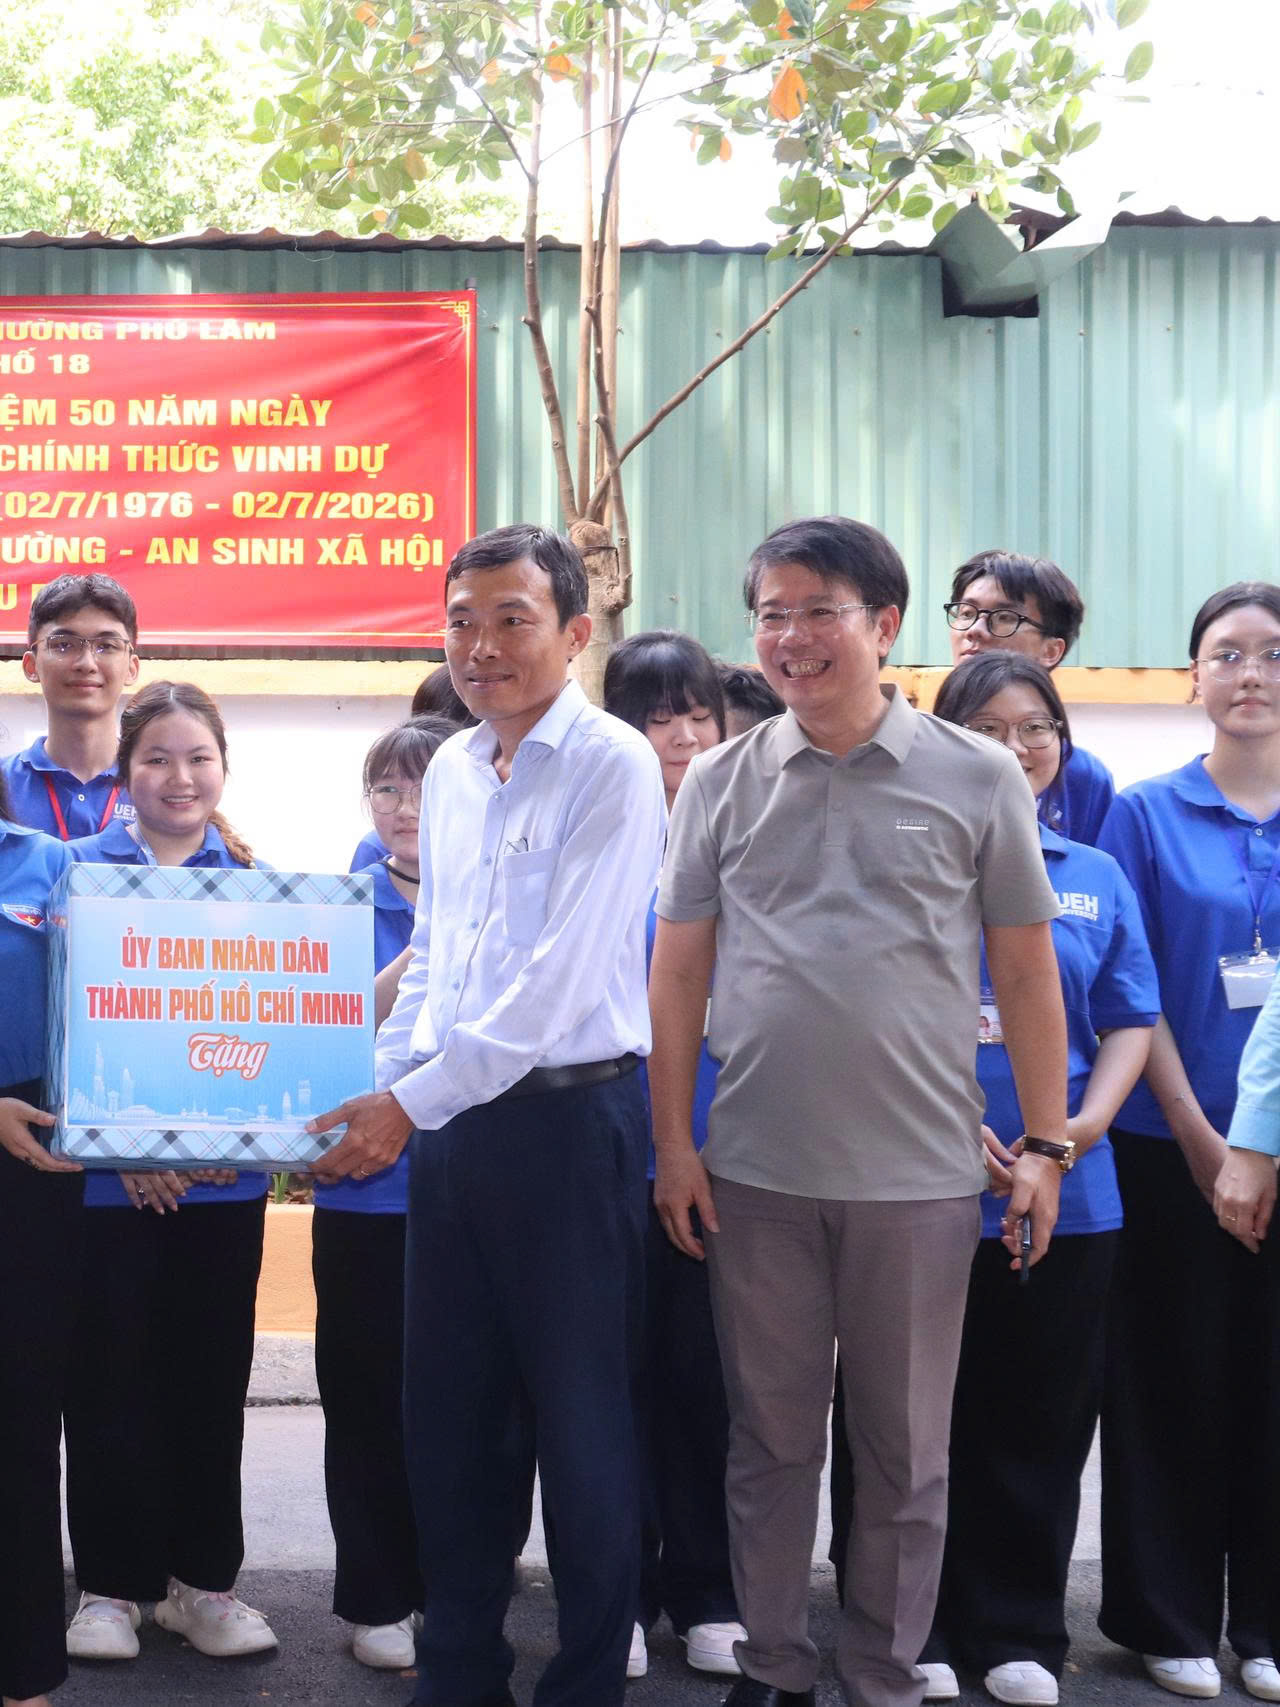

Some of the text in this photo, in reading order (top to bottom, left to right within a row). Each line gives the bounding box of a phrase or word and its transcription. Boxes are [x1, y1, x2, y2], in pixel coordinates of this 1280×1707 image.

[47, 353, 91, 375] 18
[69, 399, 116, 427] 50
[127, 393, 218, 427] NĂM
[229, 393, 332, 427] NGÀY
[121, 439, 219, 473] THỨC
[231, 444, 322, 473] VINH
[334, 442, 390, 479] DỰ
[232, 491, 435, 523] 02/7/2026)
[145, 537, 200, 565] AN
[211, 537, 305, 566] SINH
[316, 532, 369, 566] XÃ
[380, 532, 444, 572] HỘI
[1055, 892, 1099, 915] UEH
[122, 926, 329, 974] ỦY BAN NHÂN DÂN
[86, 979, 364, 1026] THÀNH PHỐ HỒ CHÍ MINH
[188, 1032, 269, 1080] Tặng
